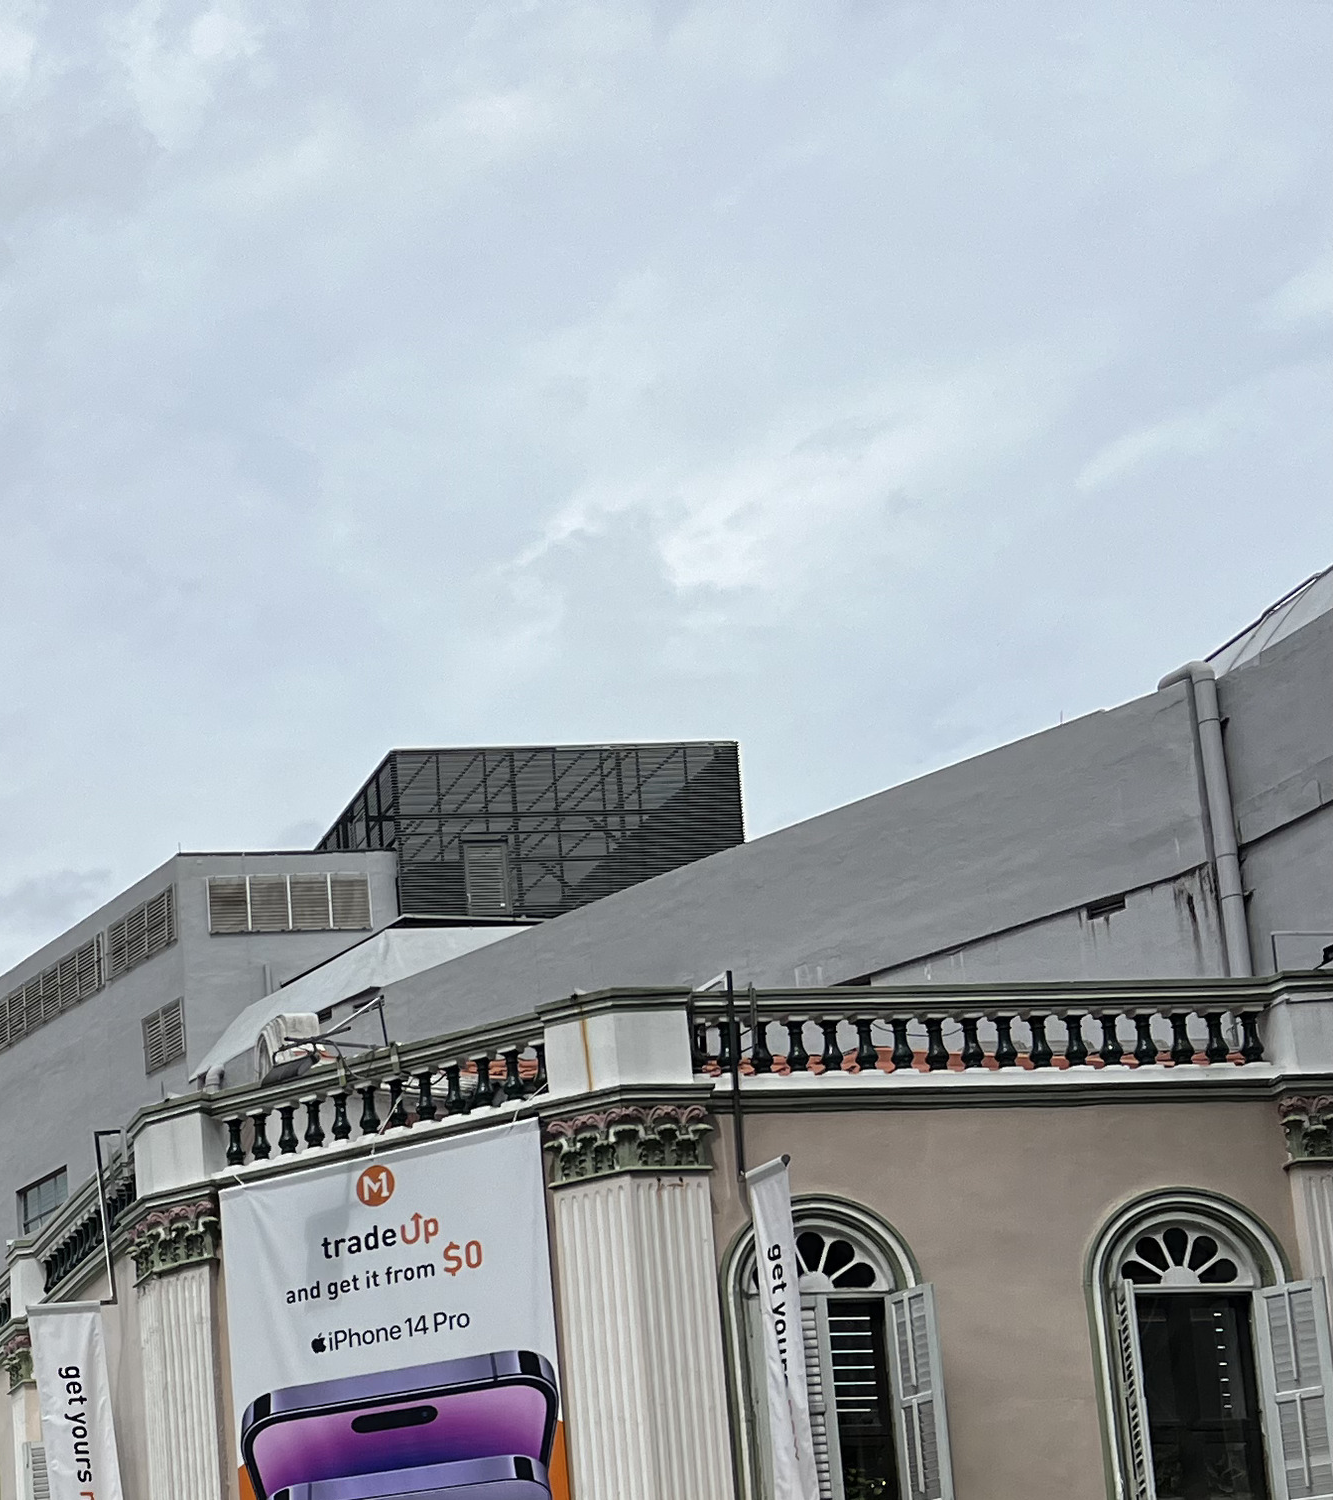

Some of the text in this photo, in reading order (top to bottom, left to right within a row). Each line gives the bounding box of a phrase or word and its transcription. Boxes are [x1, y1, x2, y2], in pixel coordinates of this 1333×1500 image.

[363, 1172, 390, 1201] M1
[286, 1240, 483, 1304] and get it from $0
[767, 1243, 788, 1294] get
[329, 1312, 470, 1351] iPhone 14 Pro
[58, 1365, 88, 1406] get
[64, 1412, 93, 1483] yours
